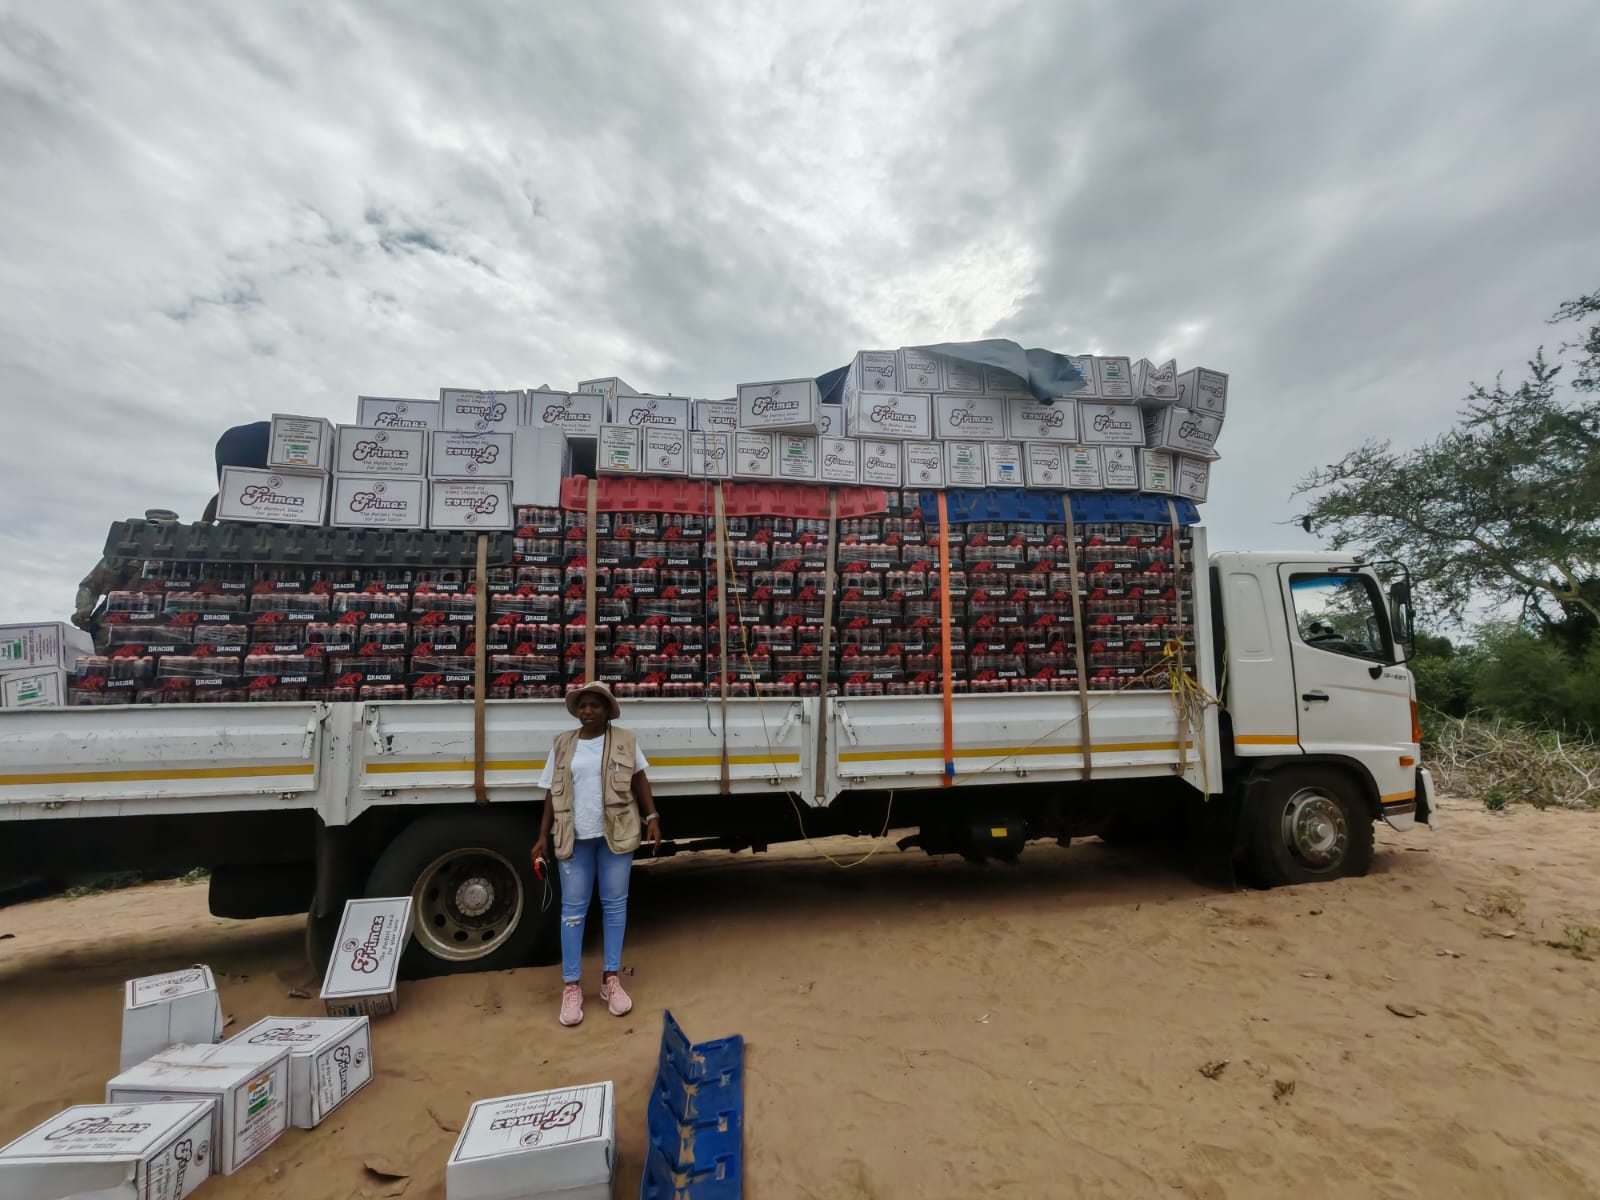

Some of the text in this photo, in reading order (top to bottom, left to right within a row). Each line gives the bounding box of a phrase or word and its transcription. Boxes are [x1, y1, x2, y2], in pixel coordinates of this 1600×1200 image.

[543, 405, 591, 423] Frimax
[752, 396, 799, 416] Frimax
[871, 405, 916, 423] Frimax
[374, 412, 427, 428] Frimax
[629, 408, 676, 425] Frimax
[950, 409, 993, 426] Frimax
[1022, 410, 1064, 427] Frimax
[1094, 415, 1132, 431] Frimax
[353, 441, 409, 461] Frimax
[446, 444, 499, 464] Frimax
[240, 485, 304, 506] Frimax
[350, 492, 407, 512] Frimax
[445, 495, 499, 514] Frimax
[108, 680, 134, 688] DRAGON
[351, 915, 385, 973] Frimax
[490, 1101, 583, 1130] Frimax
